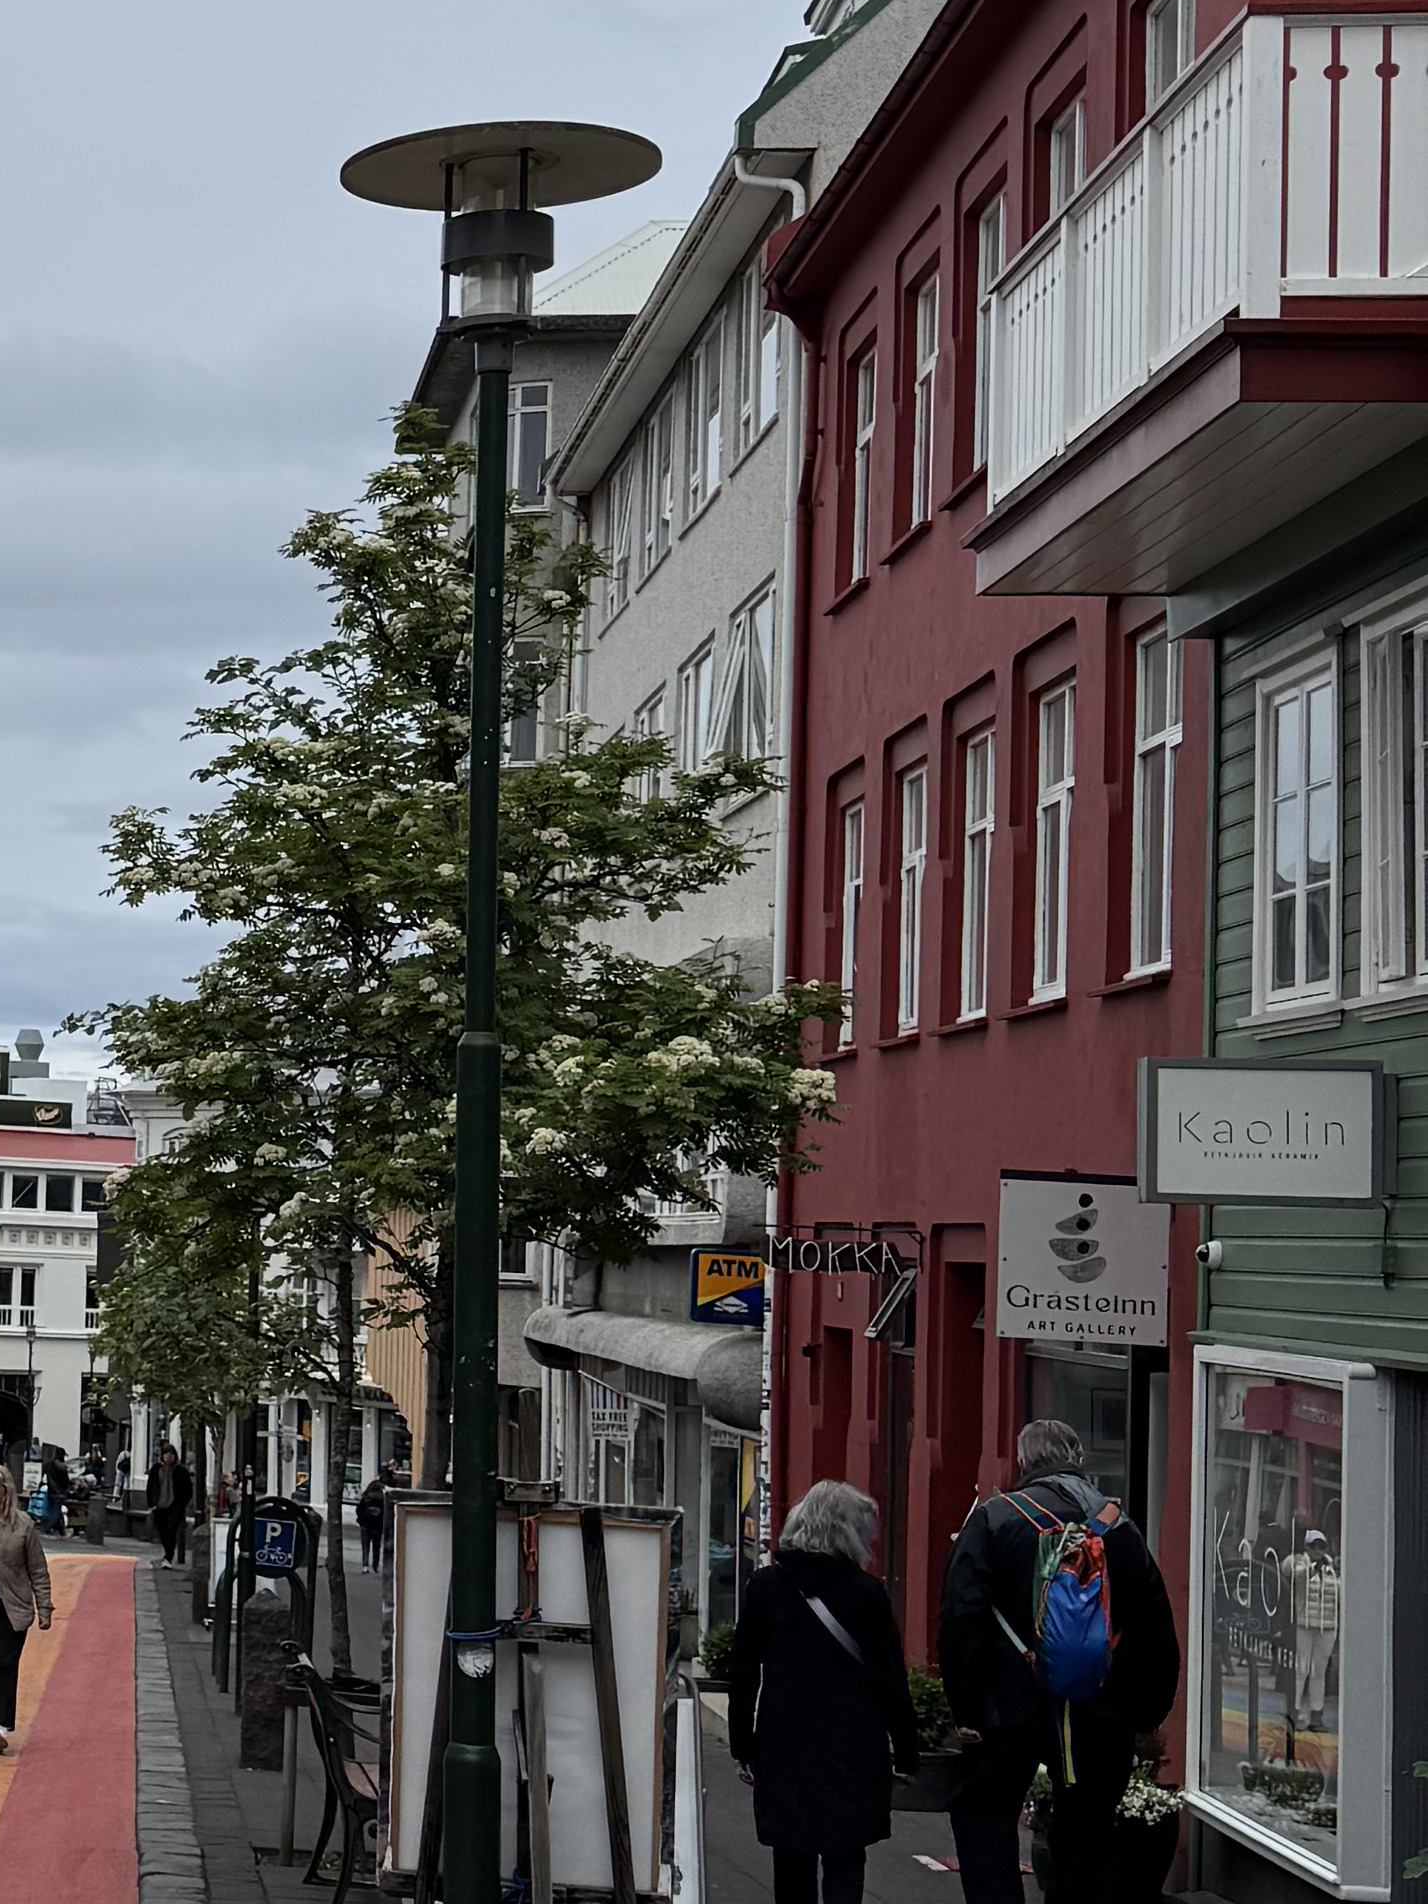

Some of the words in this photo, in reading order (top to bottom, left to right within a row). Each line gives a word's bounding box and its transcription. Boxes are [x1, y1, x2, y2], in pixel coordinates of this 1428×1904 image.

[1179, 1109, 1344, 1146] Kaolin
[769, 1237, 901, 1276] MOKKA
[707, 1259, 759, 1278] ATM
[1027, 1320, 1056, 1331] ART
[1065, 1322, 1136, 1336] GALLERY
[266, 1522, 282, 1542] P
